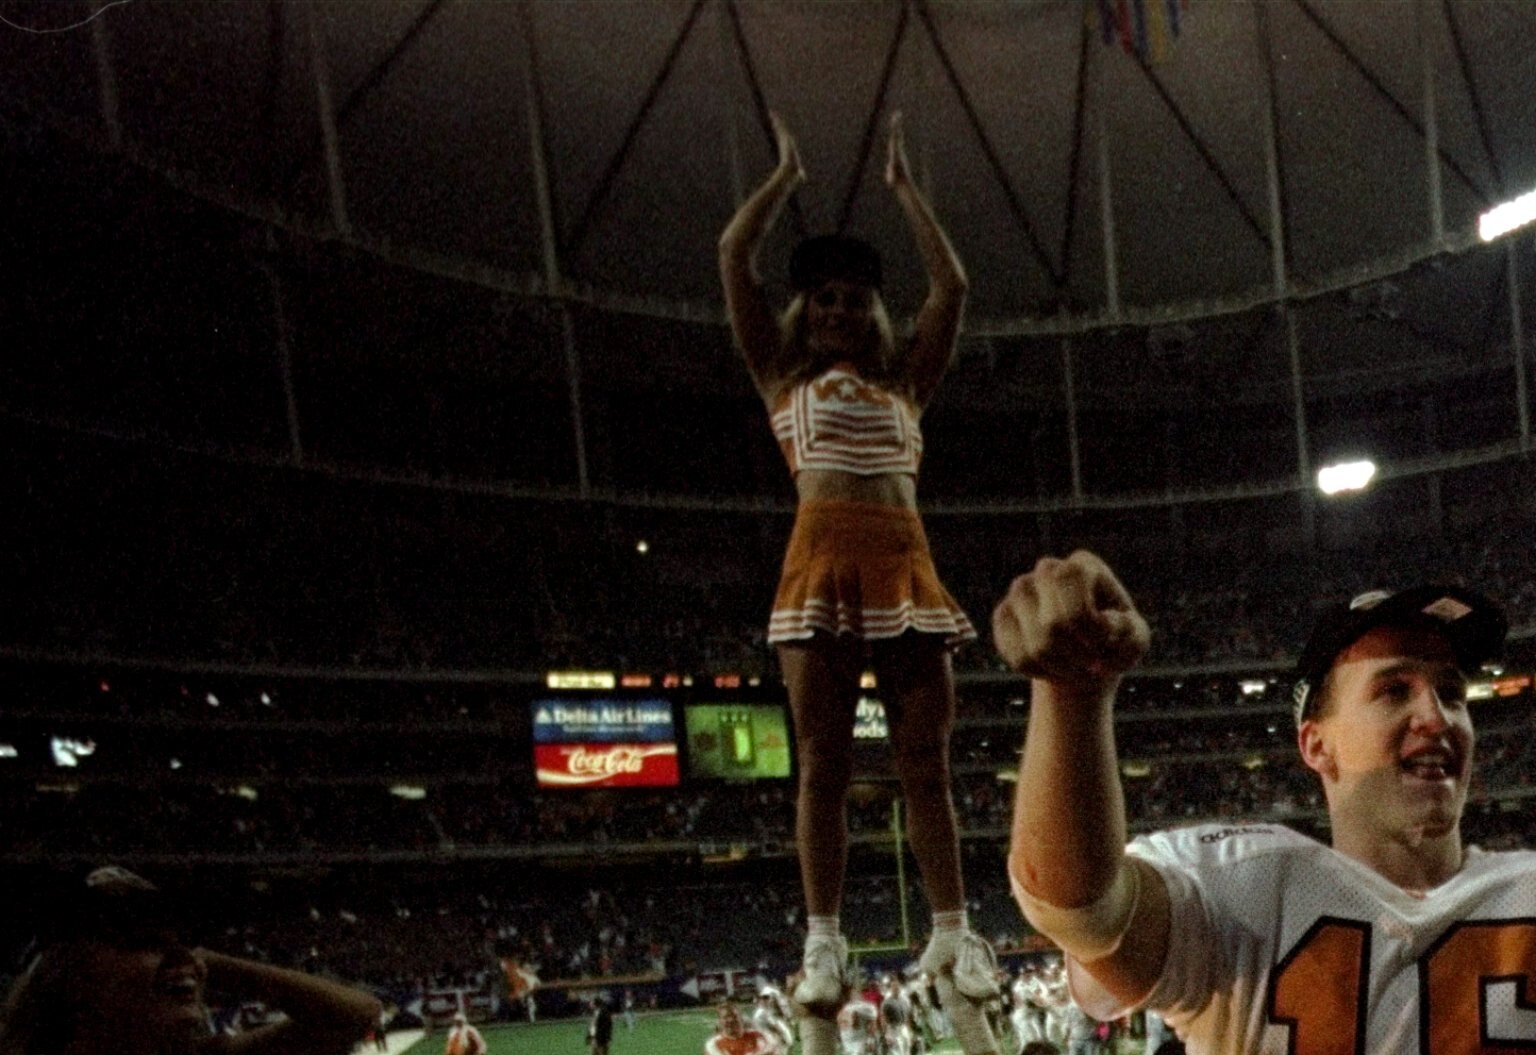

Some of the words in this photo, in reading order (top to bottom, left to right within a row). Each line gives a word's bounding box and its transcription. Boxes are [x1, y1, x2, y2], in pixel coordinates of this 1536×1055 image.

[554, 706, 598, 724] Delta
[601, 706, 626, 724] Air
[627, 706, 671, 724] Lines
